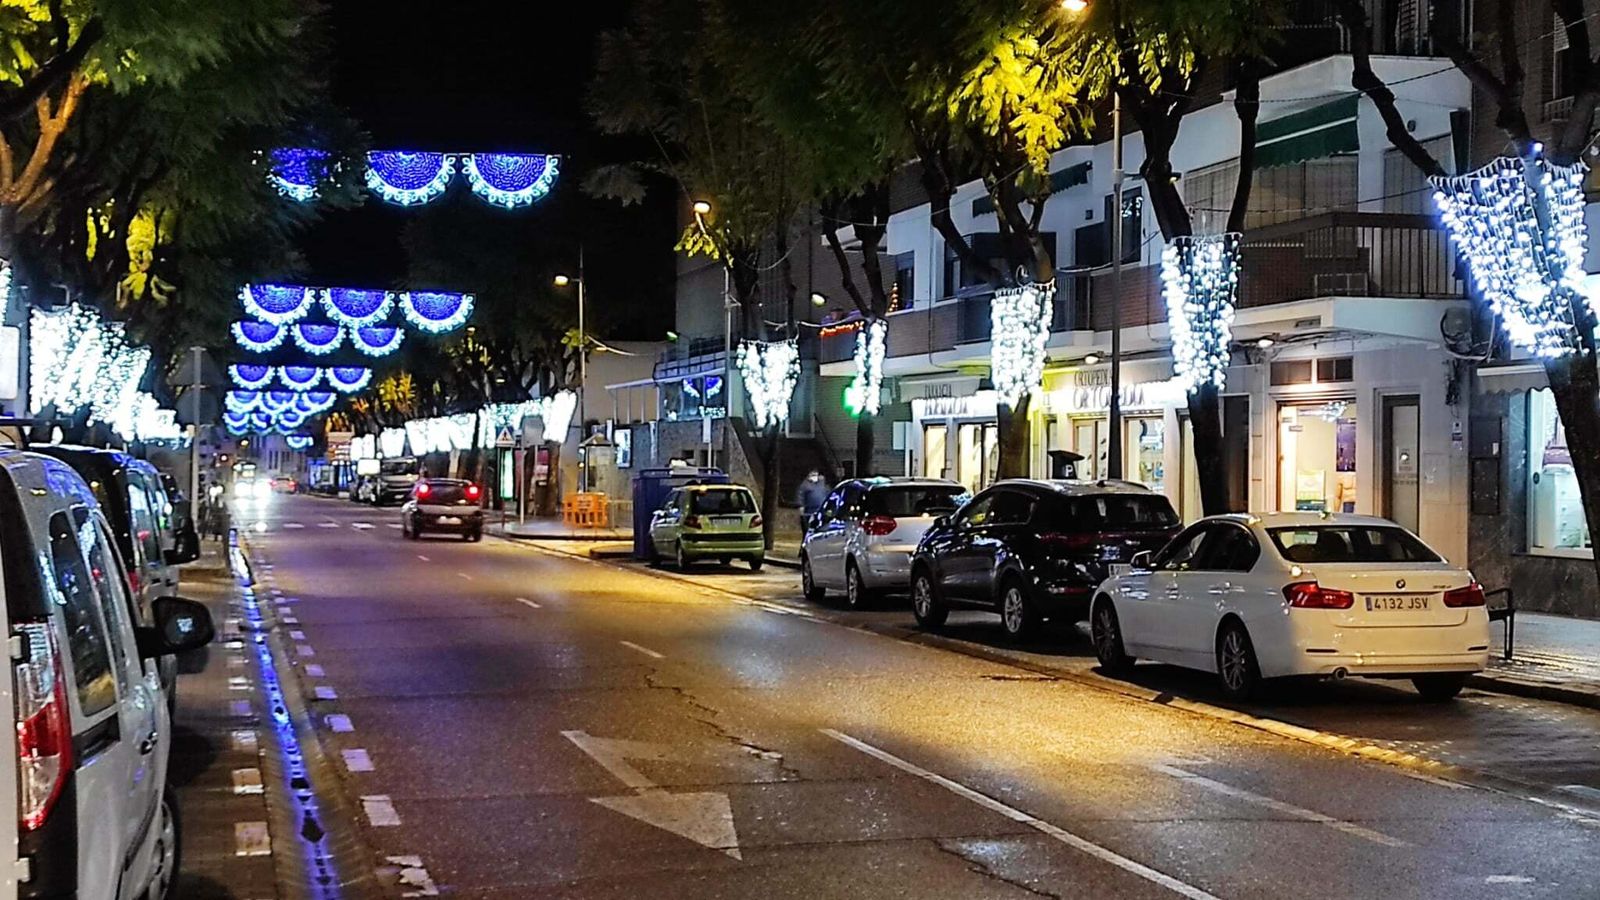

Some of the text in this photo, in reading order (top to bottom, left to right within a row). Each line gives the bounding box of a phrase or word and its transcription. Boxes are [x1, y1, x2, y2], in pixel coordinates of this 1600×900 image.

[1073, 383, 1144, 410] ORTOEDIA
[1374, 597, 1429, 610] 4132 JSV
